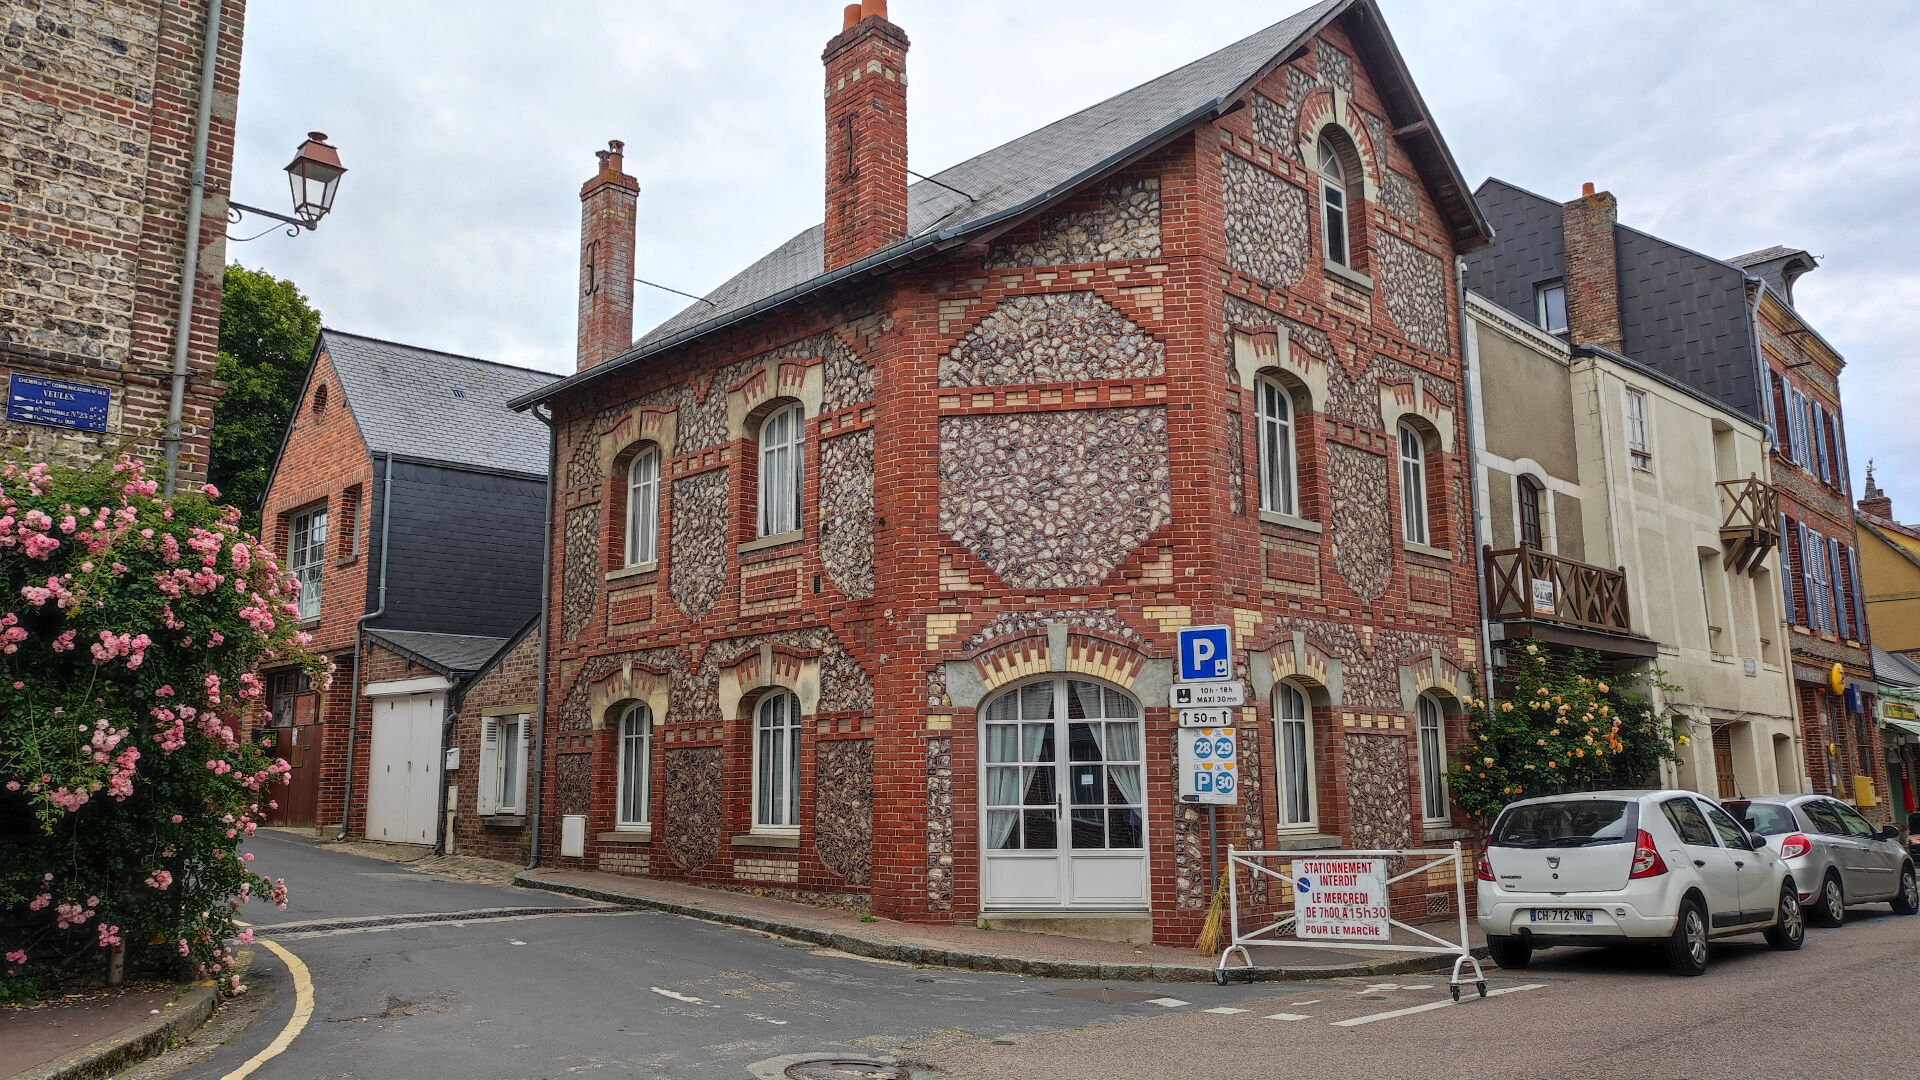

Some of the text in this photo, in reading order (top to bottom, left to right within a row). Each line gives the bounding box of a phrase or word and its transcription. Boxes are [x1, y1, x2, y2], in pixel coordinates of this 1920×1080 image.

[43, 389, 76, 401] VEULES
[42, 408, 70, 417] NATIONALE
[1193, 638, 1216, 671] P
[1800, 670, 1807, 678] LA
[1195, 741, 1211, 754] 28
[1216, 742, 1233, 755] 29
[1197, 772, 1211, 791] P
[1217, 776, 1234, 790] 30
[1304, 862, 1373, 874] STATIONNEMENT
[1320, 875, 1358, 887] INTERDIT
[1312, 892, 1322, 904] LE
[1324, 892, 1369, 905] MERCREDI
[1306, 907, 1316, 918] DE
[1319, 907, 1340, 918] 7h00
[1349, 906, 1387, 919] 15h30
[1537, 910, 1586, 921] CH-712-NK
[1305, 925, 1381, 936] POUR LE MARCHE
